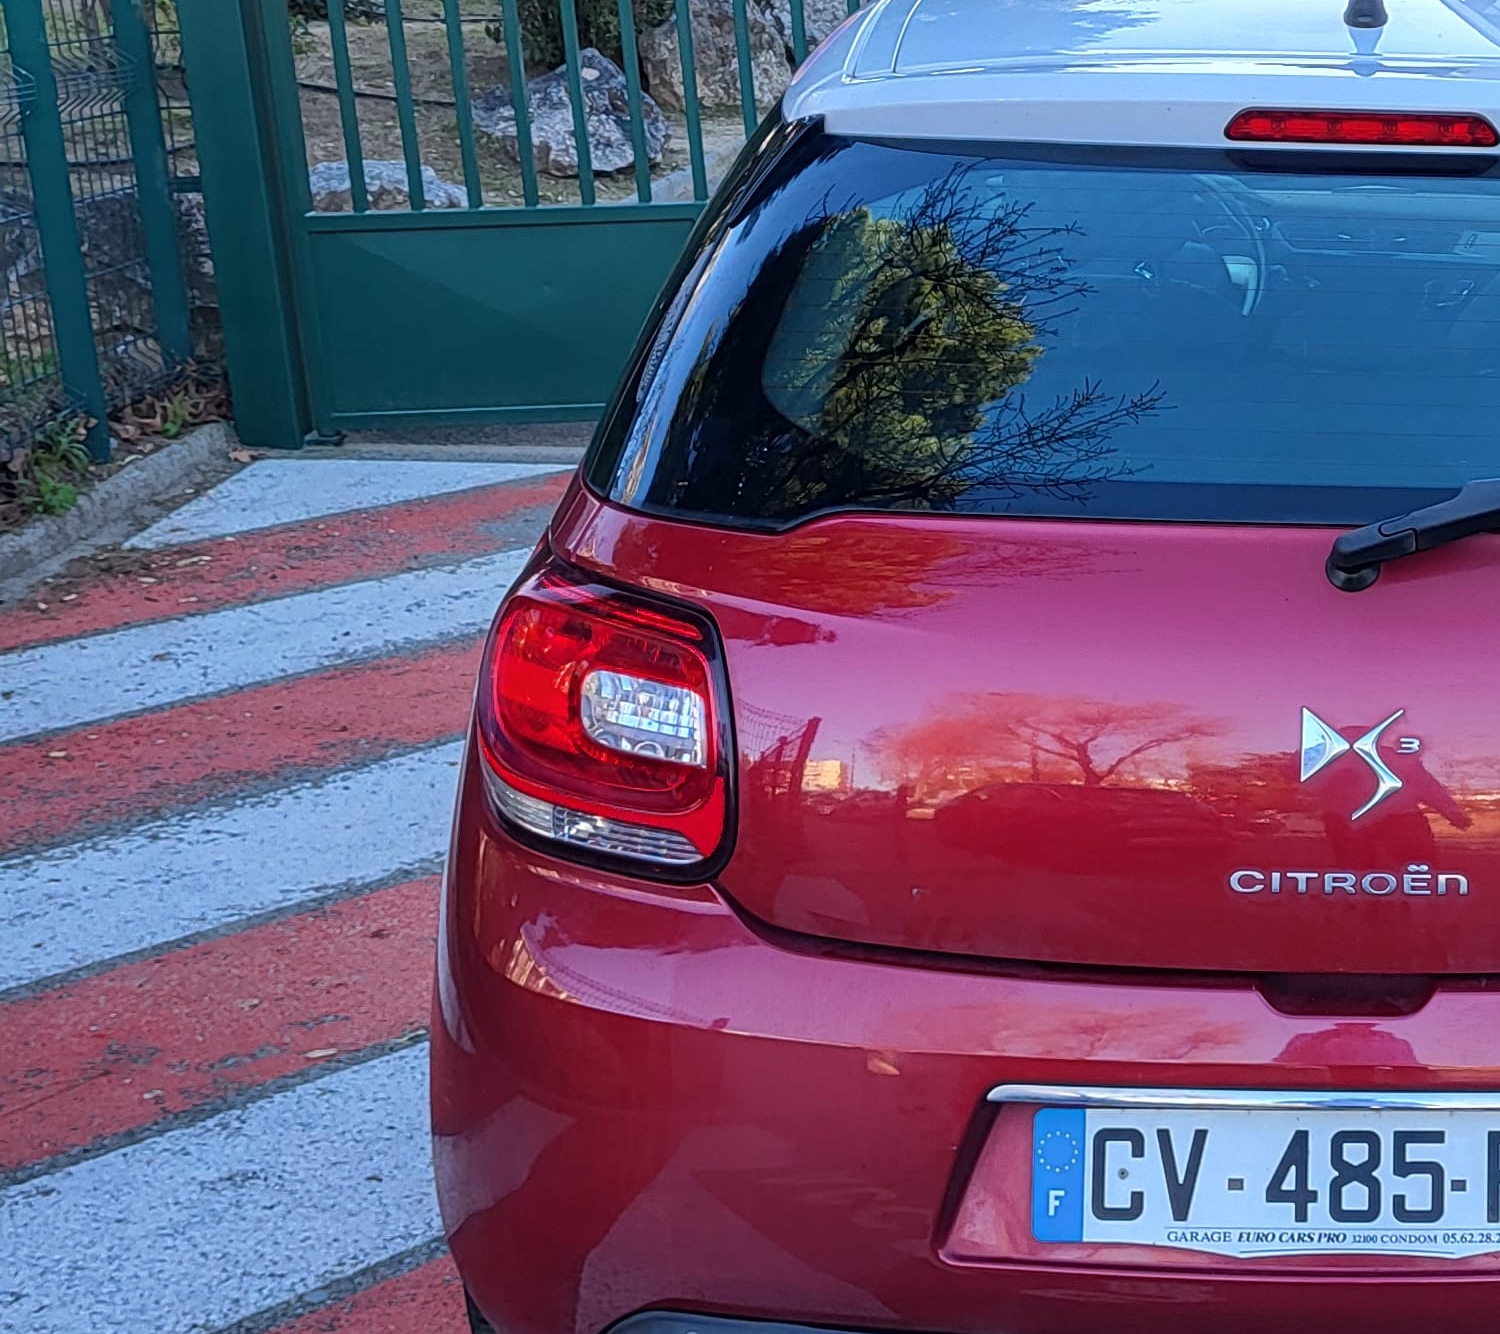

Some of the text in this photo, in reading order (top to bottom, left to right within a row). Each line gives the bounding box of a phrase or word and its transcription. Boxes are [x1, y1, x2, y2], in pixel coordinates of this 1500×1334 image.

[1048, 1190, 1065, 1216] F
[1167, 1231, 1232, 1243] GARAGE
[1237, 1231, 1276, 1244] EURO
[1278, 1232, 1315, 1244] CARS
[1316, 1232, 1347, 1244] PRO
[1352, 1234, 1378, 1244] 32100
[1380, 1233, 1438, 1244] CONDOM
